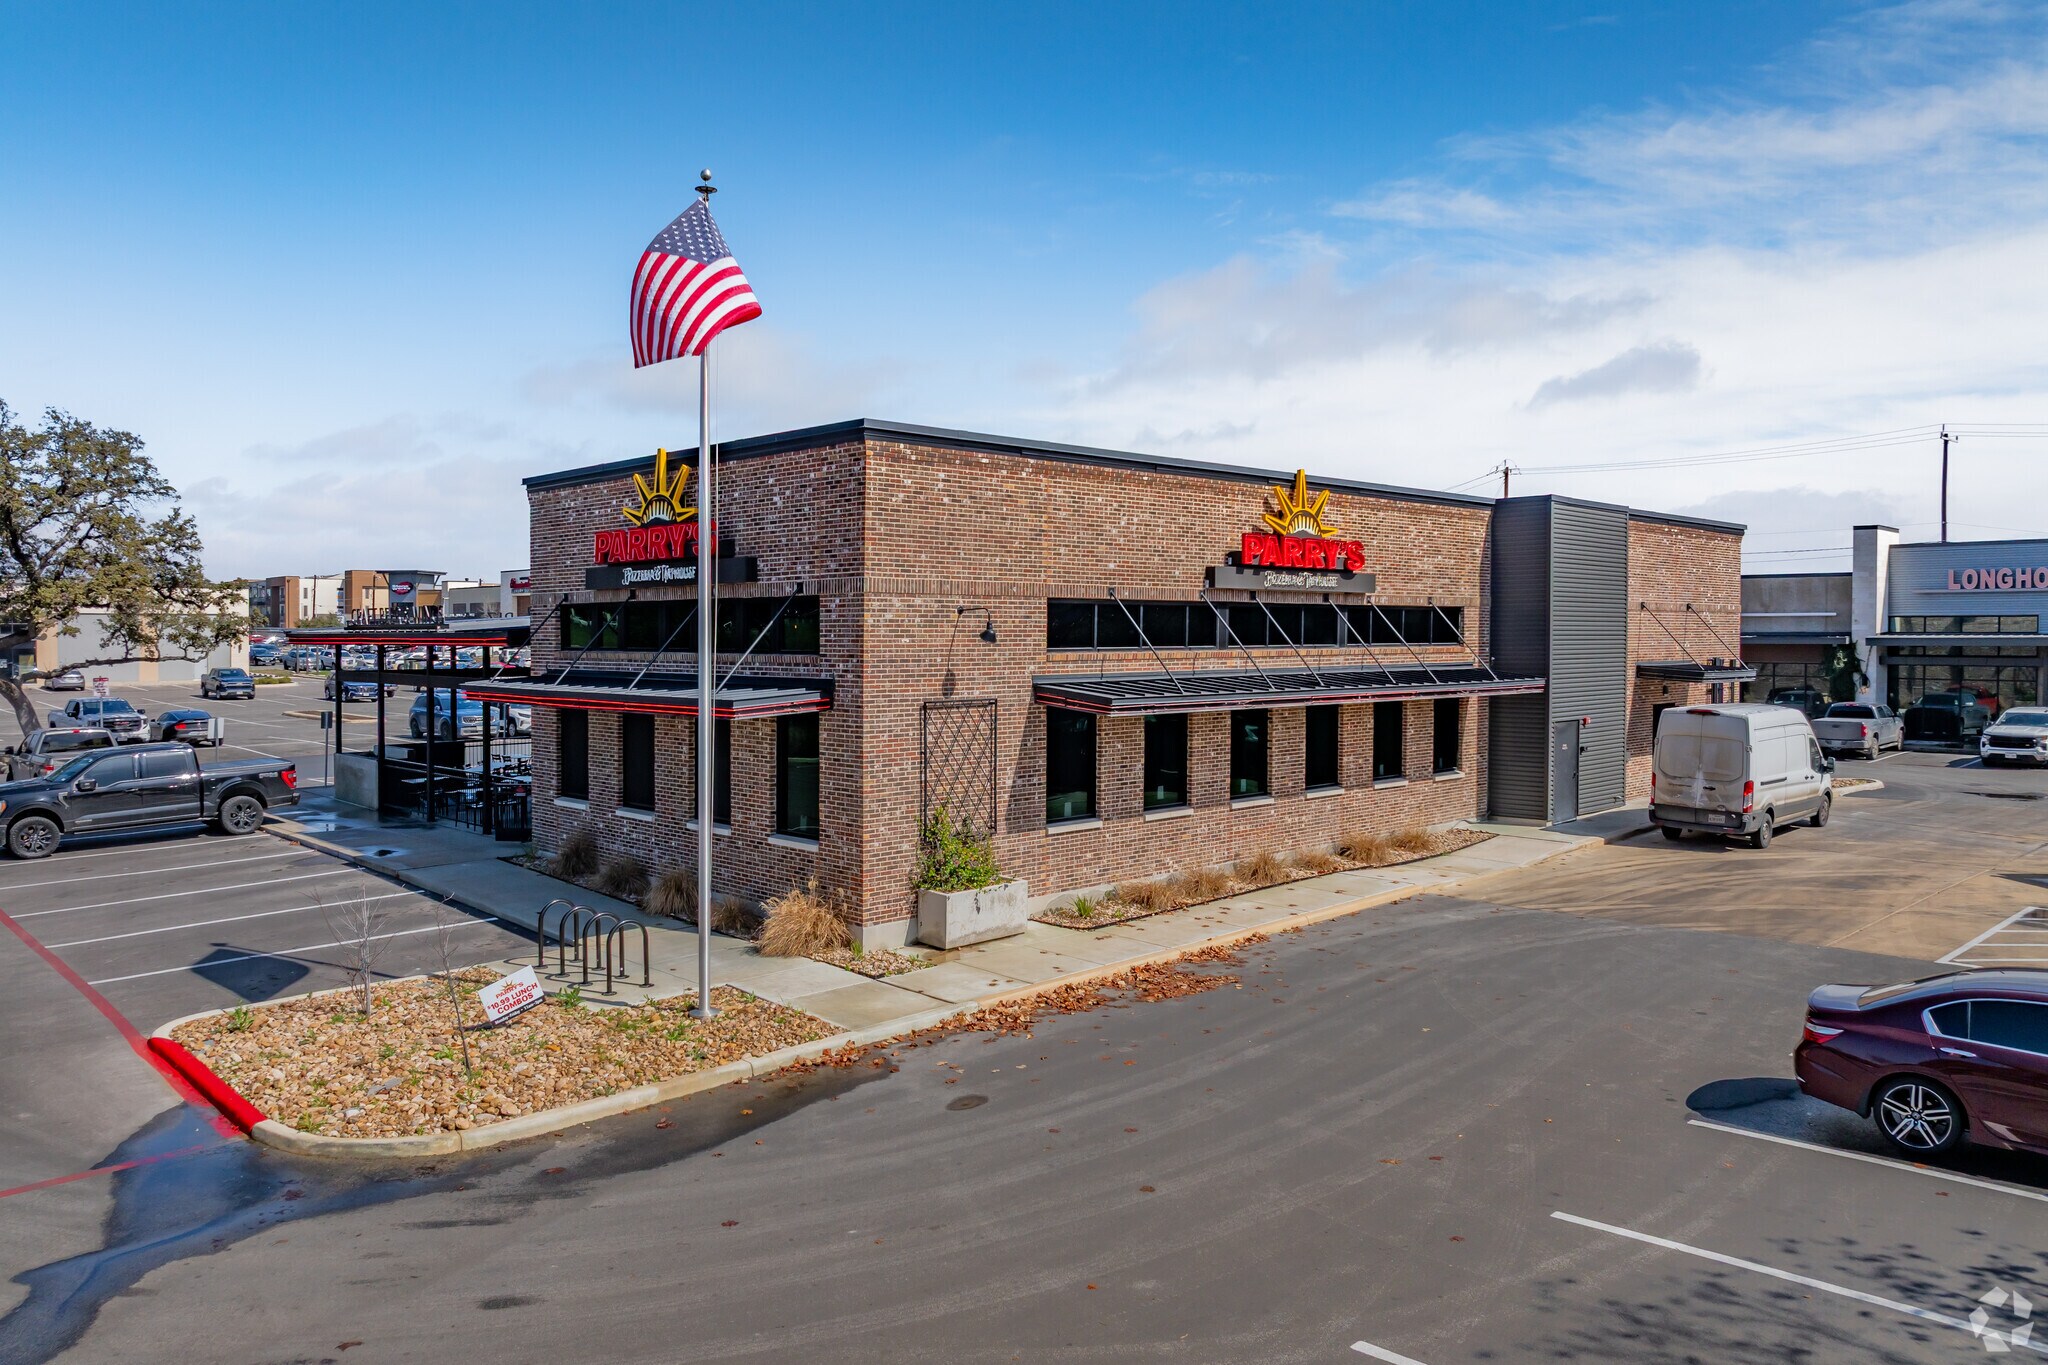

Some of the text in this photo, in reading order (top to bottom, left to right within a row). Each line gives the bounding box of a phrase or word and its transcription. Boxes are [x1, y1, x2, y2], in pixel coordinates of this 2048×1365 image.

[1242, 532, 1366, 570] PARRY'S
[1947, 567, 2048, 590] LONGHO
[511, 982, 538, 1000] LUNCH
[497, 992, 534, 1014] COMBOS
